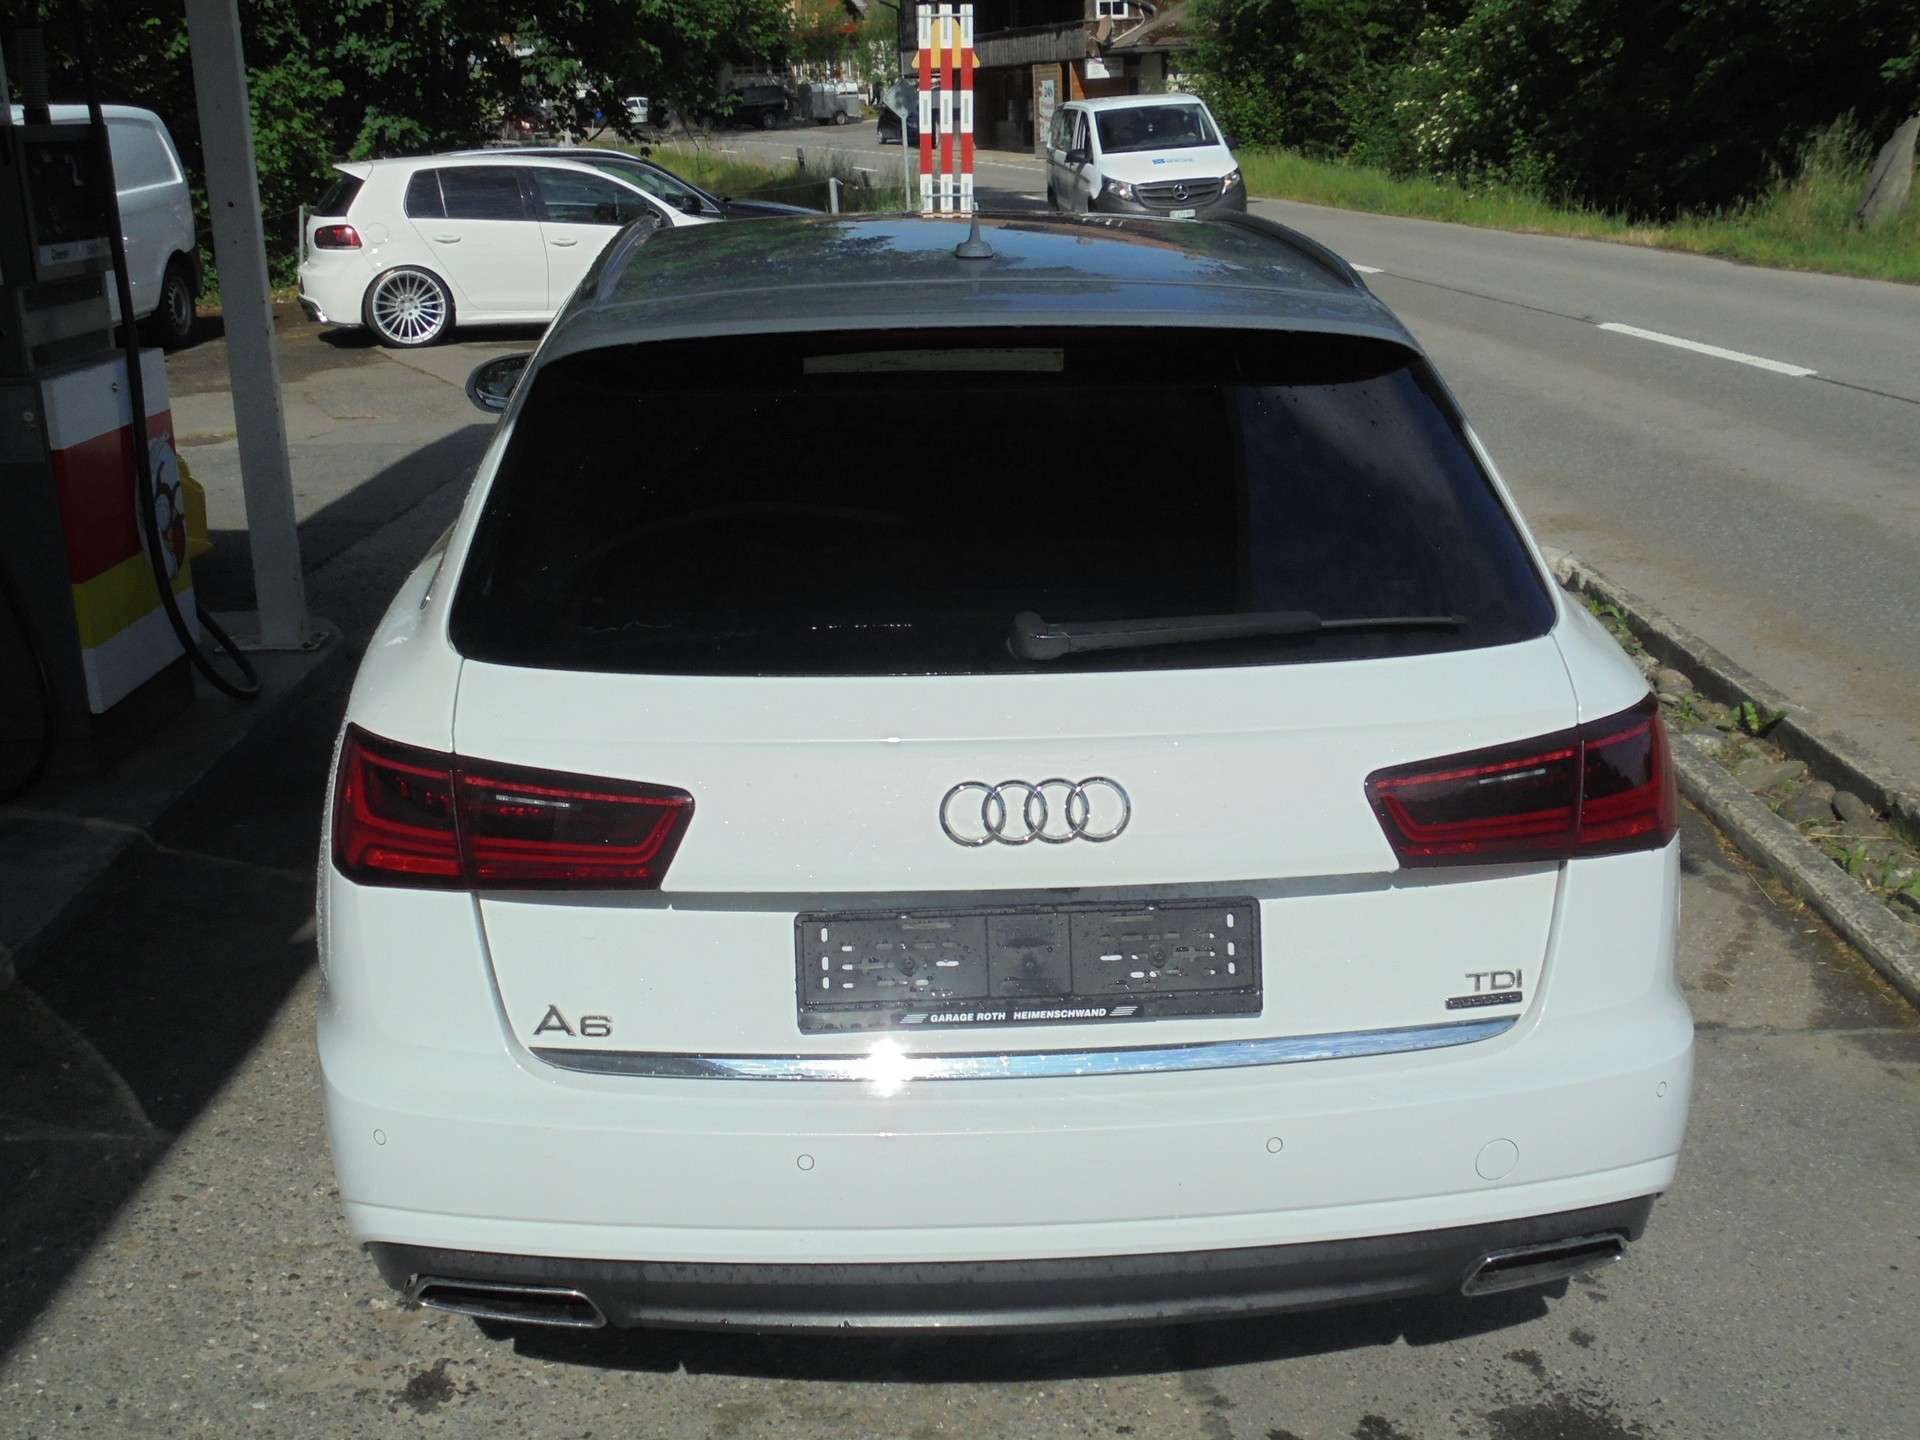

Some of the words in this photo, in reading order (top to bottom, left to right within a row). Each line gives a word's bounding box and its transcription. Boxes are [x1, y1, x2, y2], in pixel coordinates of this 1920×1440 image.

[1465, 969, 1522, 992] TDI
[533, 1004, 611, 1037] A6
[930, 1012, 974, 1023] GARAGE
[977, 1011, 1006, 1021] ROTH
[1013, 1008, 1107, 1020] HEIMENSCHWAND
